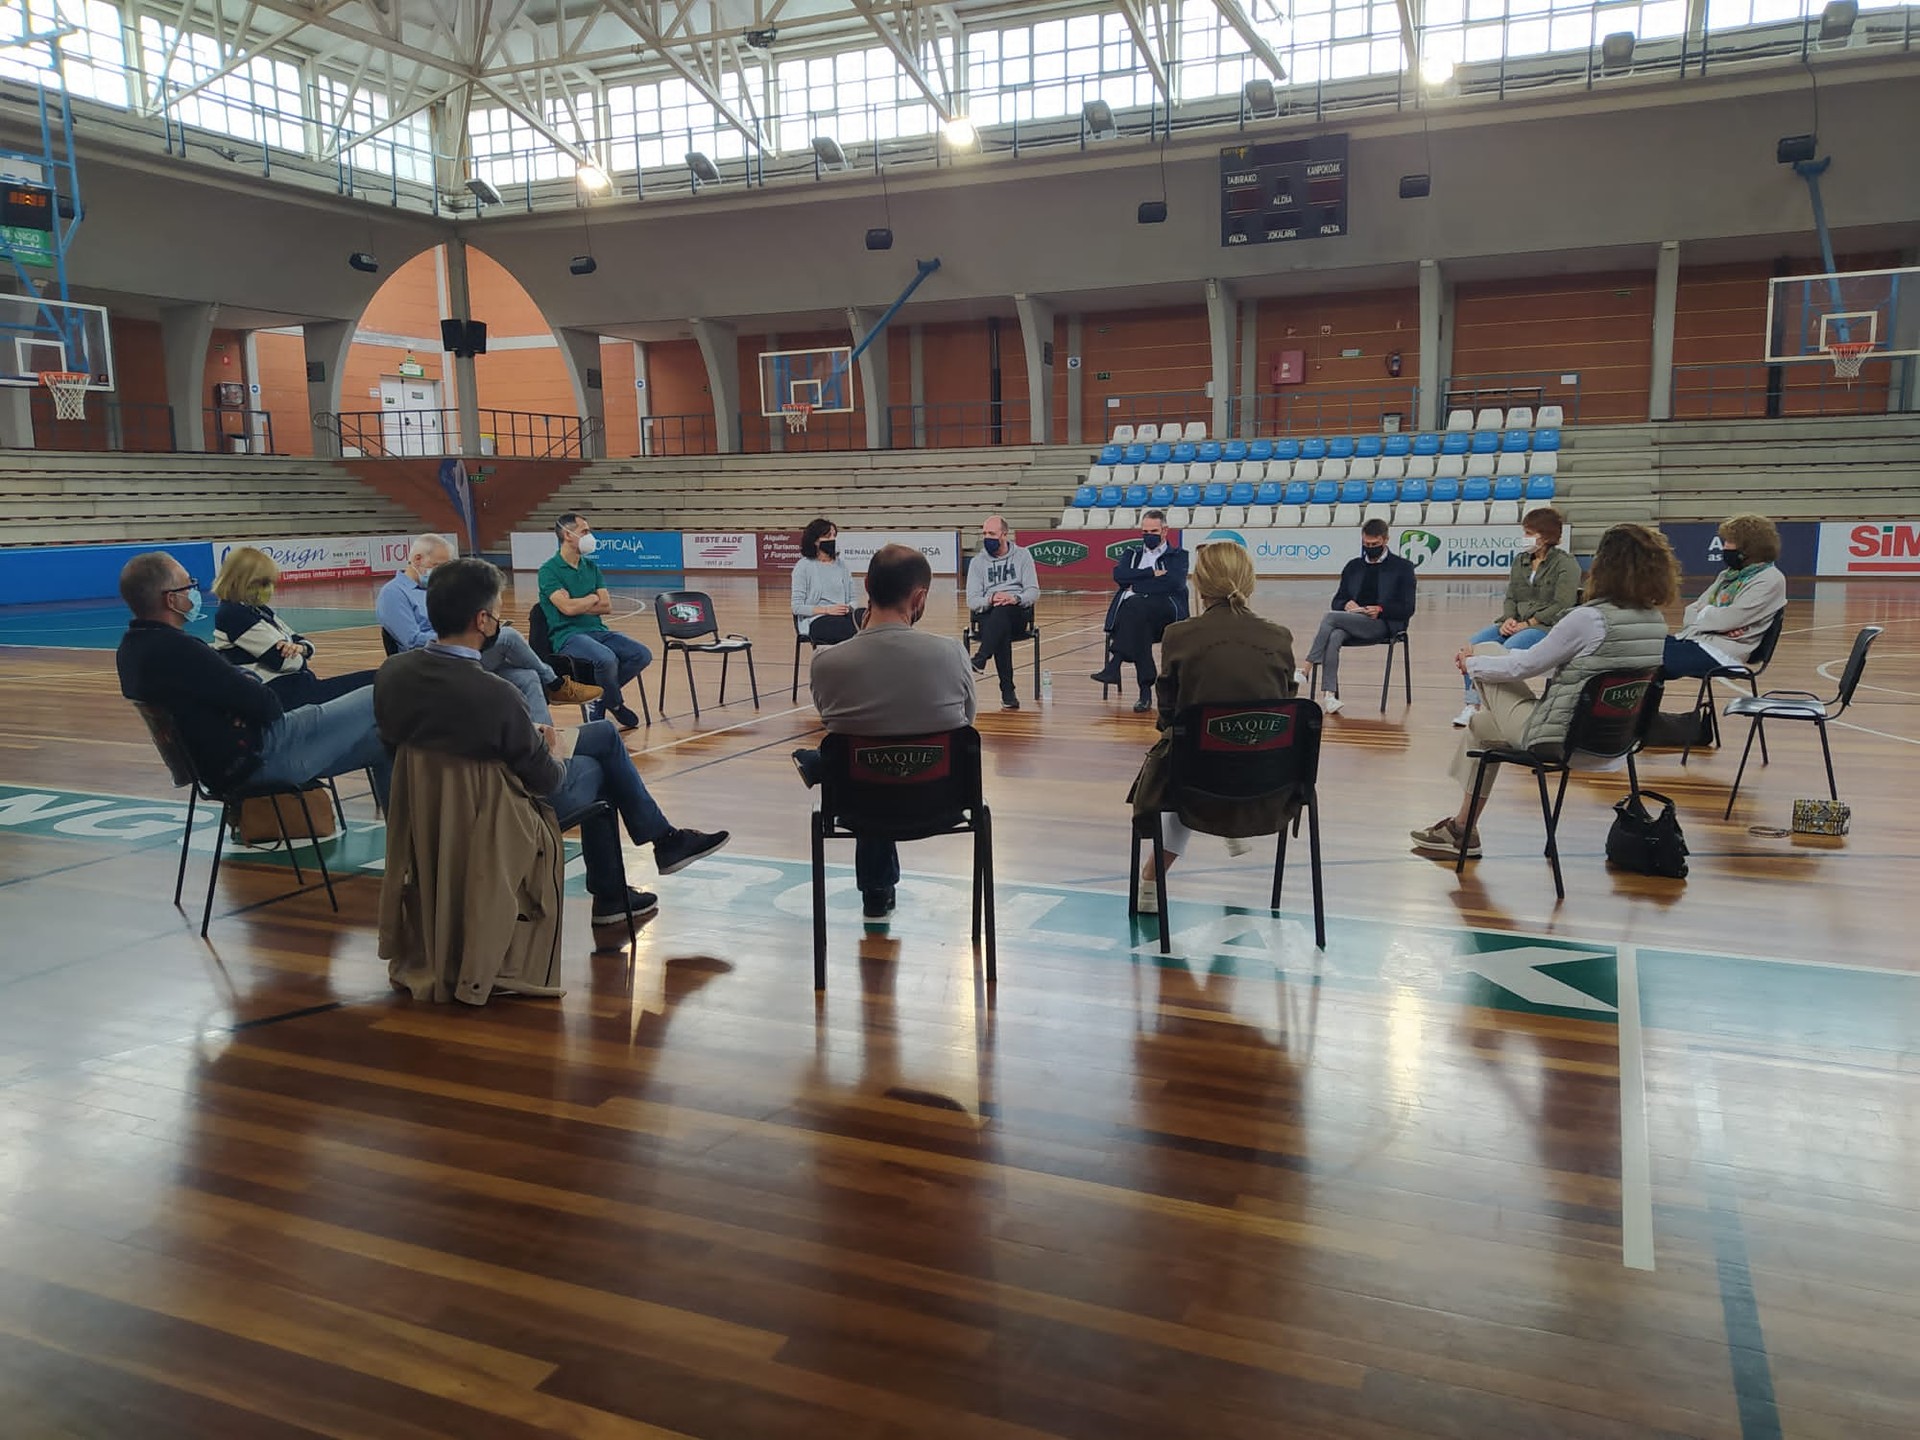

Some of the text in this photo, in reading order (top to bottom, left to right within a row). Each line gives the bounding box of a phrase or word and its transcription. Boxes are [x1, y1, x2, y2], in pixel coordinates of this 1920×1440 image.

[1307, 163, 1340, 175] KANPOKOAK
[1227, 174, 1257, 184] TABIRAKO
[1273, 195, 1292, 205] ALDIA
[1321, 224, 1340, 234] FALTA
[1229, 234, 1247, 243] FALTA
[763, 534, 790, 543] Alquiler
[1256, 540, 1331, 560] durango
[770, 552, 802, 561] Furgonet
[283, 572, 311, 580] Limpieza
[313, 570, 335, 578] interior
[343, 568, 365, 576] exterior
